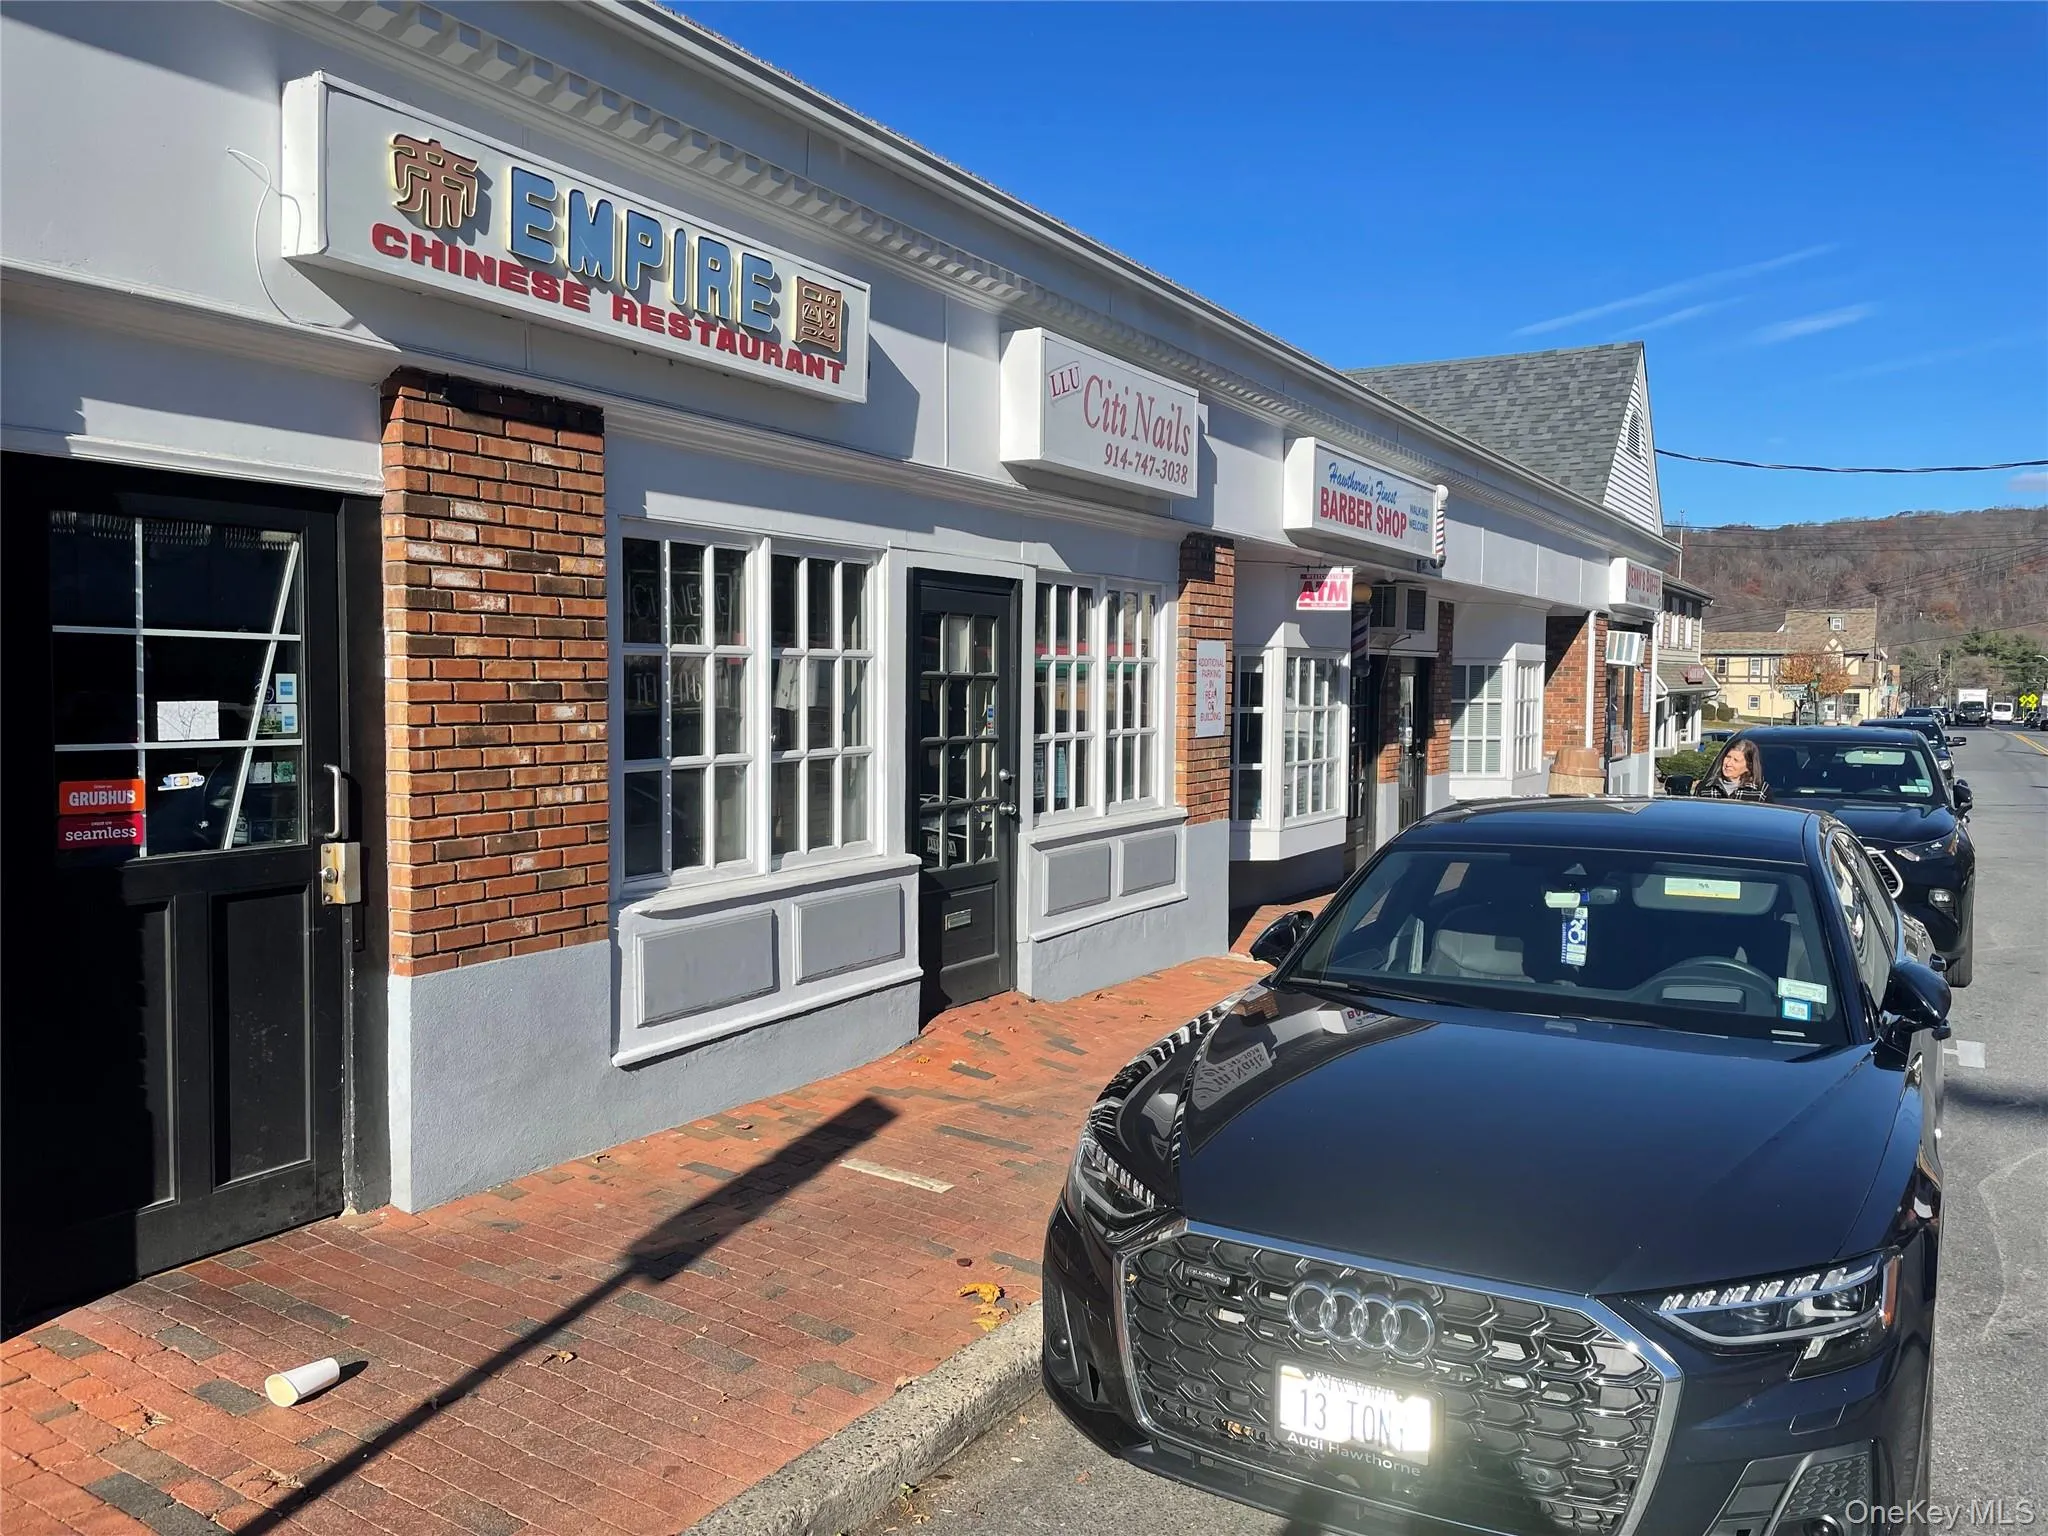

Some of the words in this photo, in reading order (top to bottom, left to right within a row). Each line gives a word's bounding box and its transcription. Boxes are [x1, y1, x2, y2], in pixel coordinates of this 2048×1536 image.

[391, 134, 479, 229] 帝
[508, 166, 776, 333] EMPIRE
[371, 222, 592, 312] CHINESE
[612, 295, 845, 385] RESTAURANT
[1050, 366, 1081, 398] LLU
[1083, 374, 1130, 438] Citi
[1131, 391, 1191, 457] Nails
[1104, 442, 1189, 485] 914-747-3038
[1328, 461, 1374, 497] Hawthorne's
[1320, 486, 1373, 531] BARBER
[1376, 505, 1407, 539] SHOP
[1299, 580, 1349, 602] ATM
[1201, 669, 1222, 679] PARKING
[1200, 711, 1222, 722] BUILDING
[69, 789, 136, 808] GRUBHUB
[65, 824, 137, 842] seamless
[1301, 1388, 1327, 1431] 13
[1287, 1431, 1323, 1450] Audi
[1328, 1441, 1421, 1477] Hawthorne
